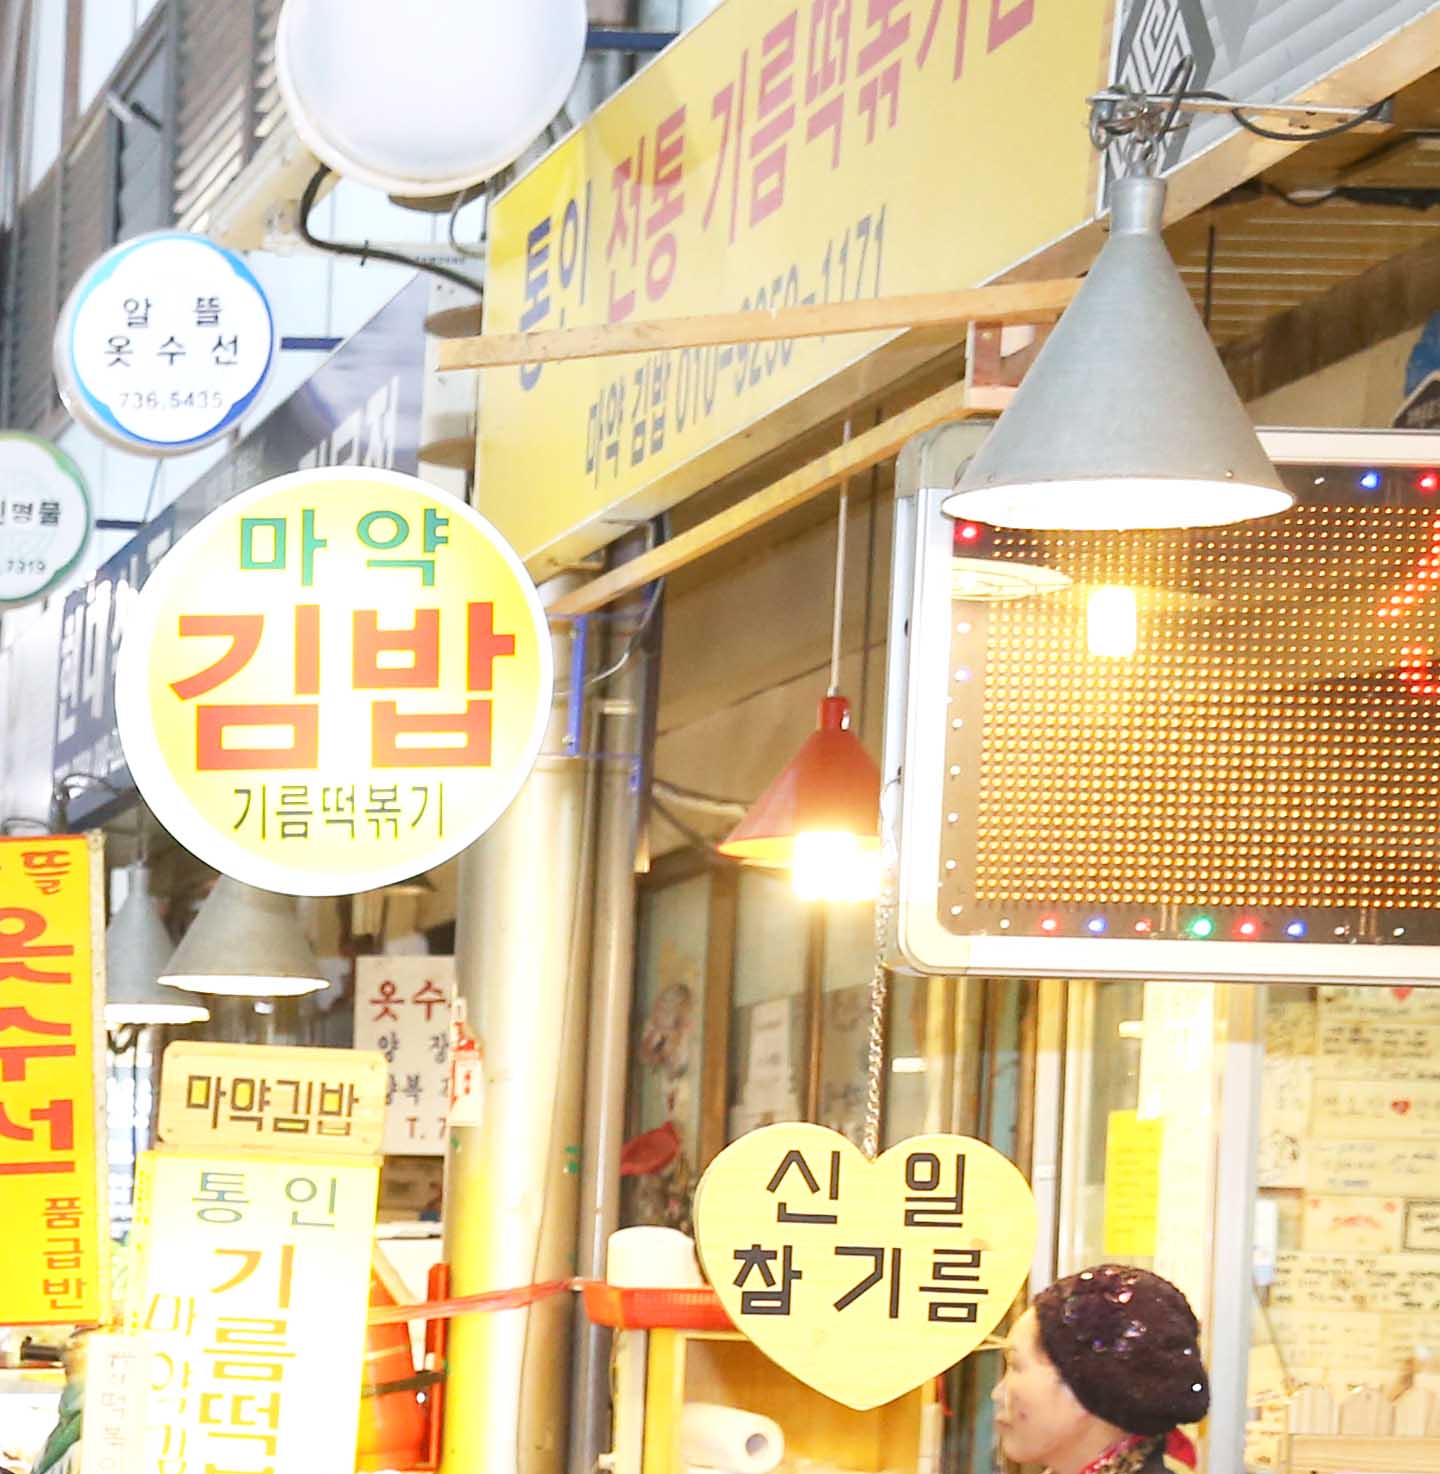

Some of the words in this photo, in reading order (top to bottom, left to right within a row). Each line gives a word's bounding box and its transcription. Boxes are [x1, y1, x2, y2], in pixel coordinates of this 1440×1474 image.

[169, 602, 516, 771] 김밥
[233, 782, 445, 841] 기름떡볶기
[369, 979, 452, 1022] 옷수
[186, 1074, 359, 1137] 마약김밥
[732, 1243, 989, 1324] 참기름
